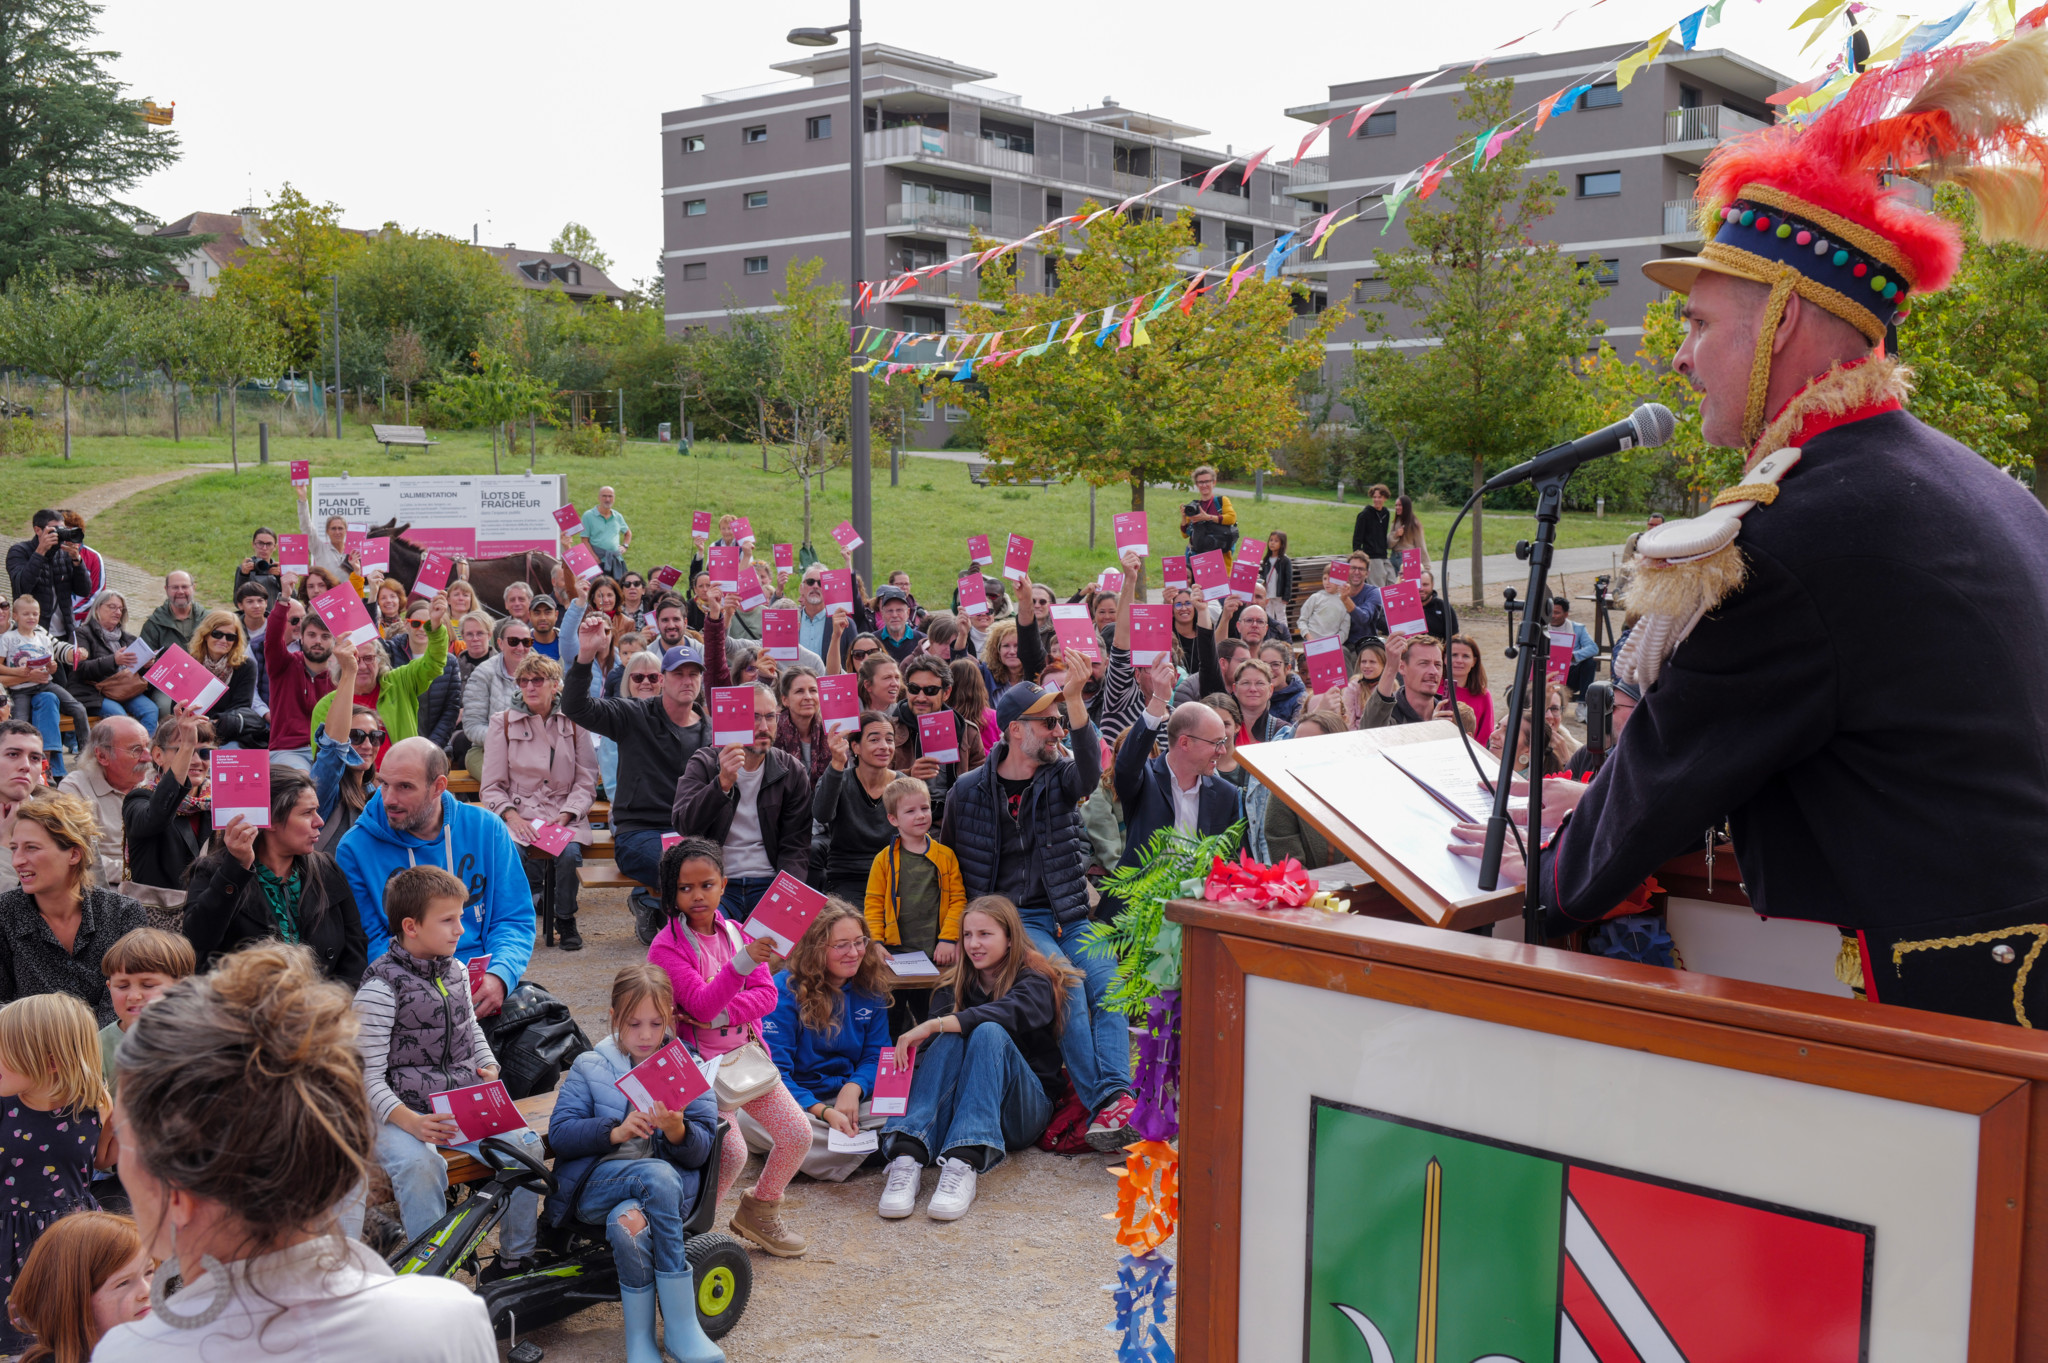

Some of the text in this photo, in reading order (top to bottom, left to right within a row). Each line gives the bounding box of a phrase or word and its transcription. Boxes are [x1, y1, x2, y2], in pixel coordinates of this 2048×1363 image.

[512, 492, 526, 500] DE
[350, 498, 365, 506] DE
[318, 506, 370, 516] MOBILITÉ
[680, 648, 690, 656] C
